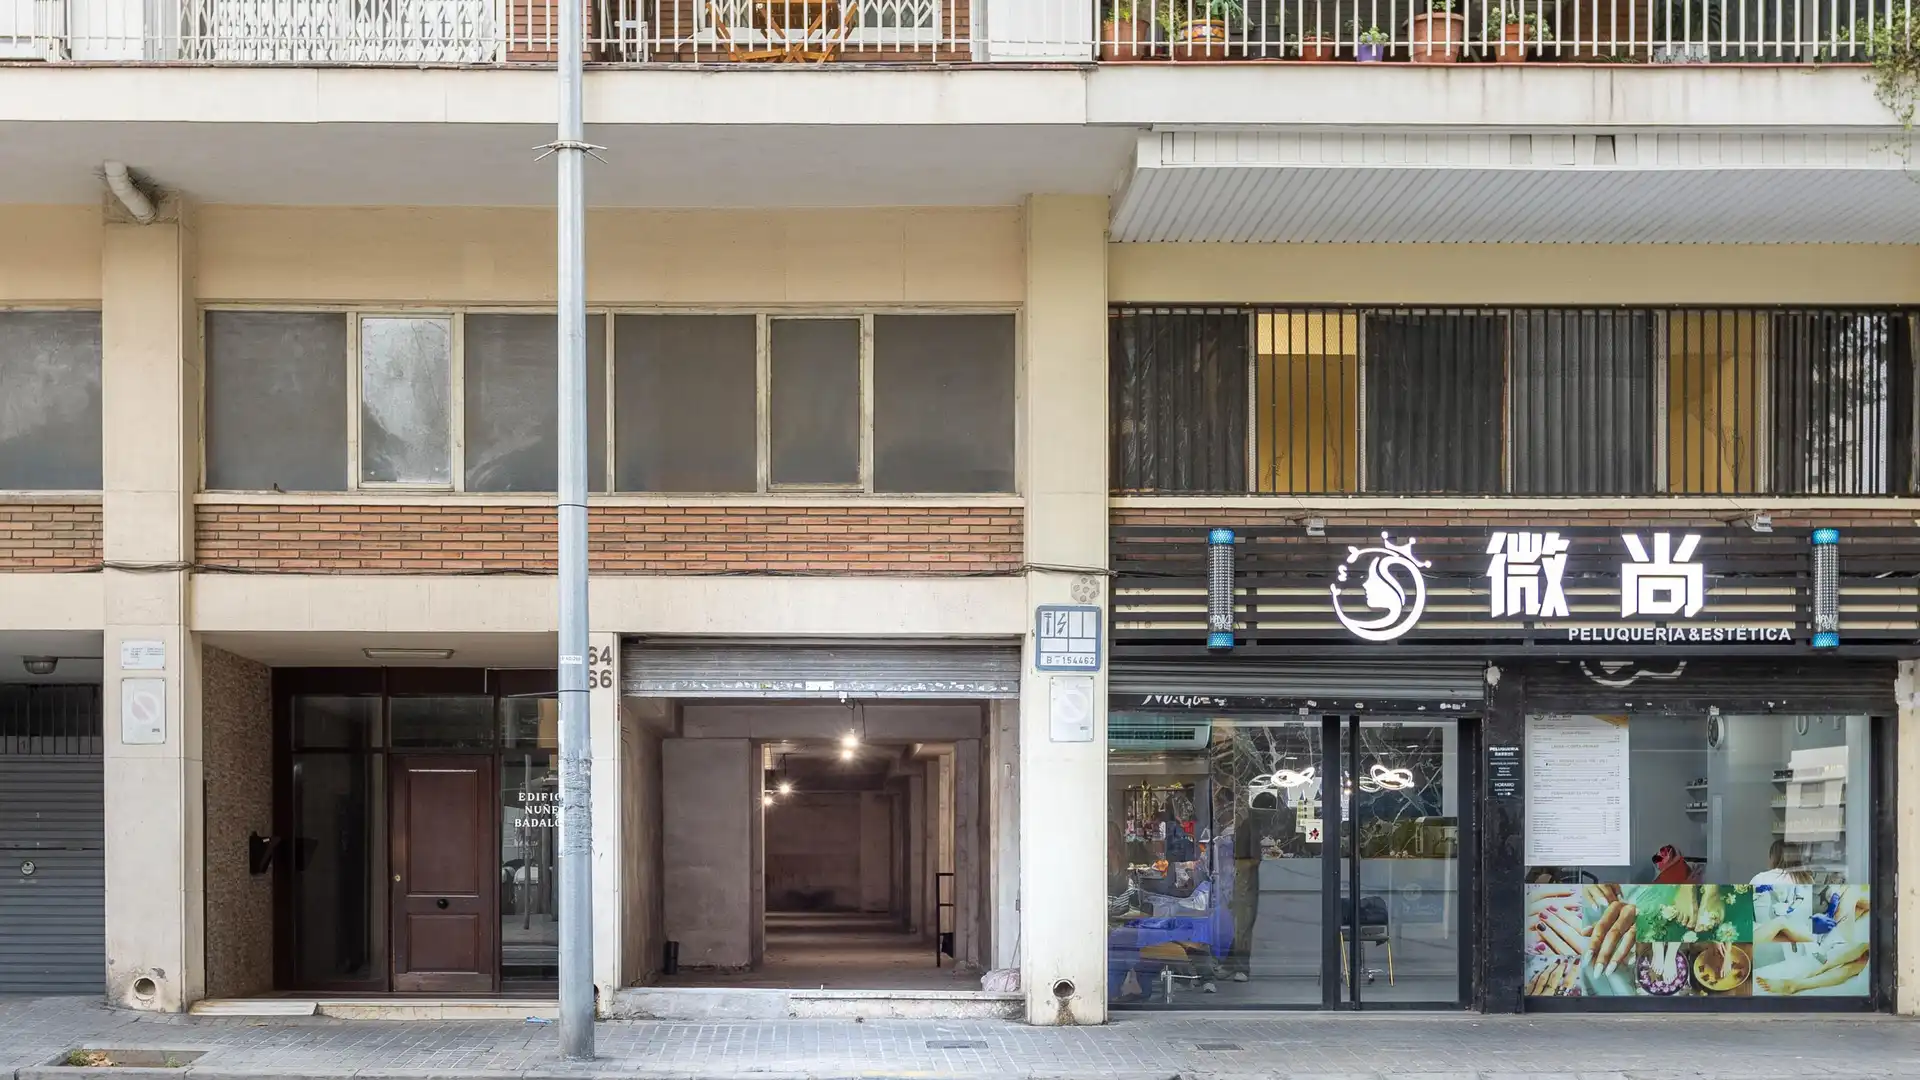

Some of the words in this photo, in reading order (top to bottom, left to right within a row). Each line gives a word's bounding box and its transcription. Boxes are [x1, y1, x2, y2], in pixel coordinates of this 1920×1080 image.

[589, 646, 612, 666] 64
[589, 669, 612, 689] 66
[518, 792, 560, 802] EDIFIC
[524, 803, 559, 815] NUÑE
